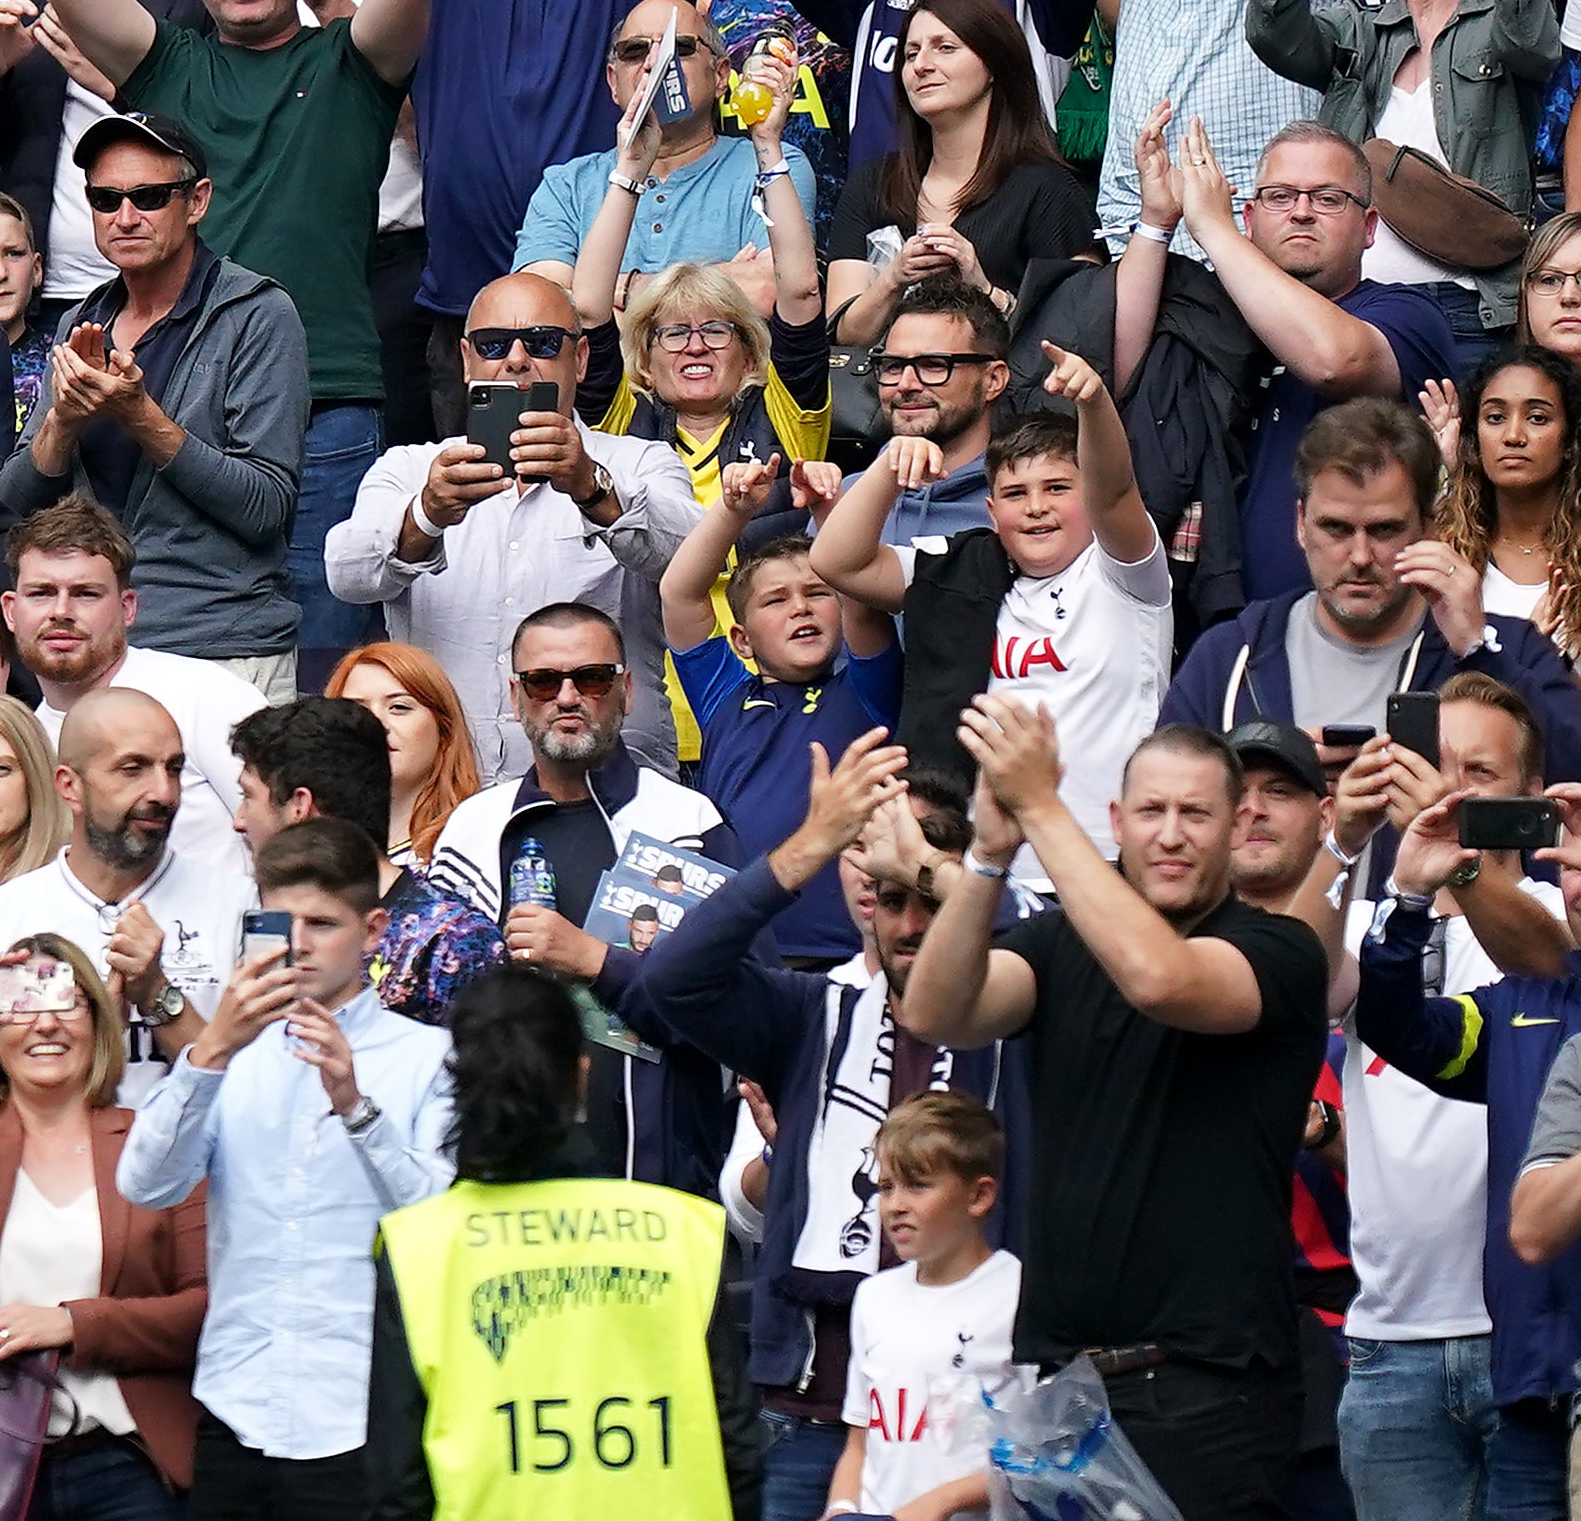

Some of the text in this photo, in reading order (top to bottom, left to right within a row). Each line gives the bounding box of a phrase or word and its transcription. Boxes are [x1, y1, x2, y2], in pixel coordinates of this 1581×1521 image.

[615, 883, 686, 928] SPUR
[465, 1209, 667, 1248] STEWARD
[496, 1395, 674, 1475] 1561
